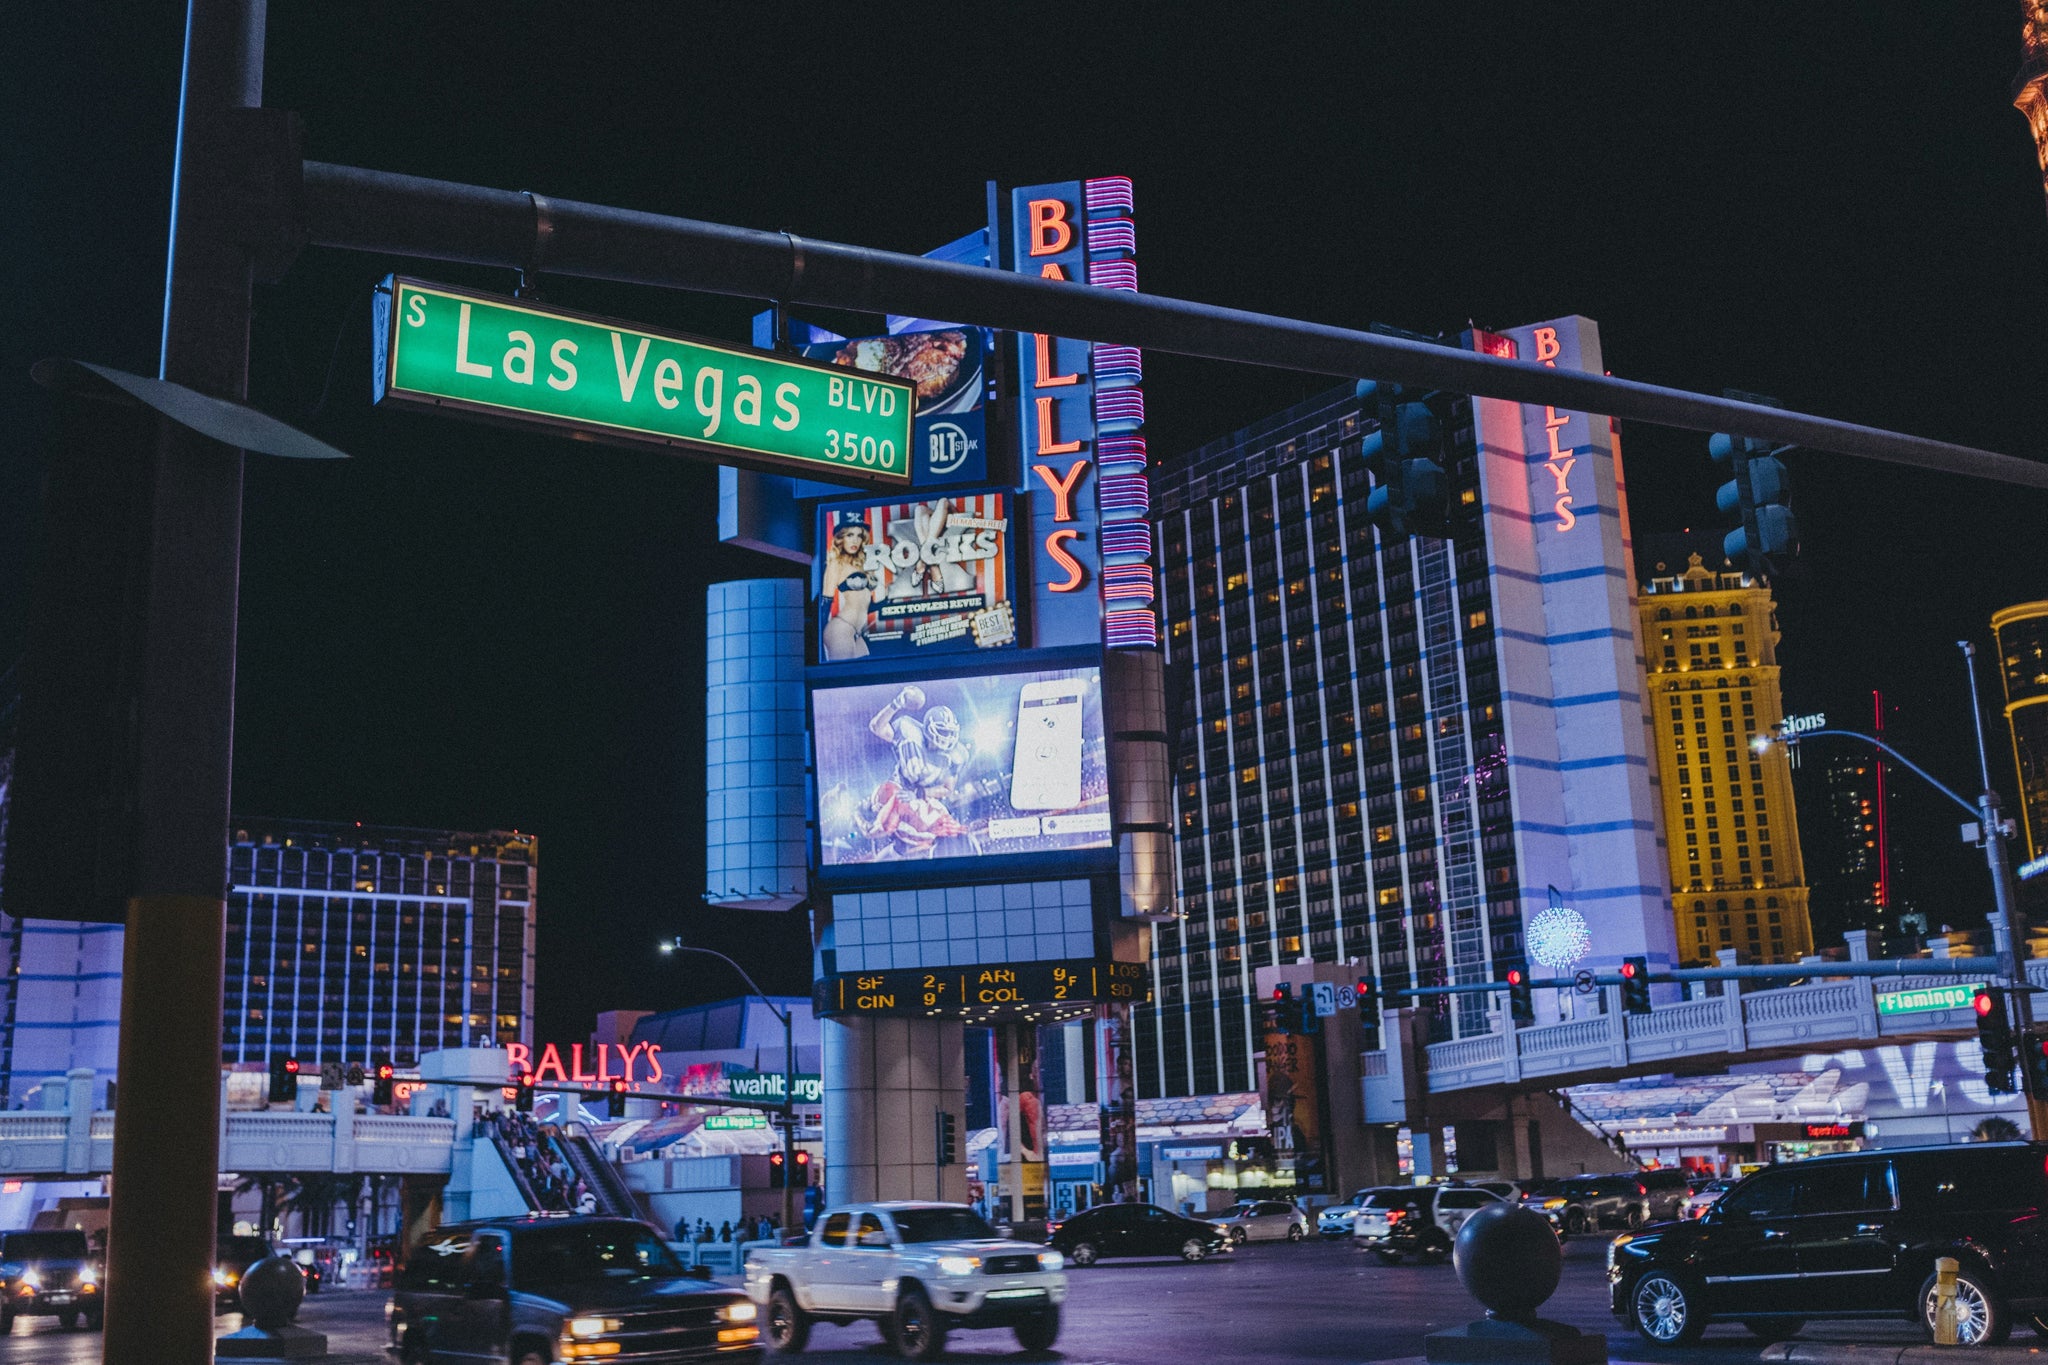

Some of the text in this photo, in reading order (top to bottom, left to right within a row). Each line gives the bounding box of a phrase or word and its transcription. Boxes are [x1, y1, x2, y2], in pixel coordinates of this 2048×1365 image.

[406, 294, 427, 328] S
[455, 302, 579, 391] Las
[609, 331, 801, 438] Vegas
[828, 376, 896, 418] BLVD
[1533, 327, 1577, 532] BLLYS
[824, 429, 895, 469] 3500
[929, 432, 958, 462] BLT
[863, 531, 999, 574] ROCKS
[881, 597, 982, 616] SEXY TOPLESS REVUE
[980, 614, 1000, 630] BEST
[857, 974, 946, 993] SF 2 F
[979, 967, 1077, 986] ARI 9 F
[857, 992, 936, 1009] CIN 9
[978, 985, 1067, 1003] COL 2
[1885, 989, 1965, 1010] Flamingo
[506, 1040, 663, 1084] BALLY'S
[1274, 1126, 1294, 1149] IPA
